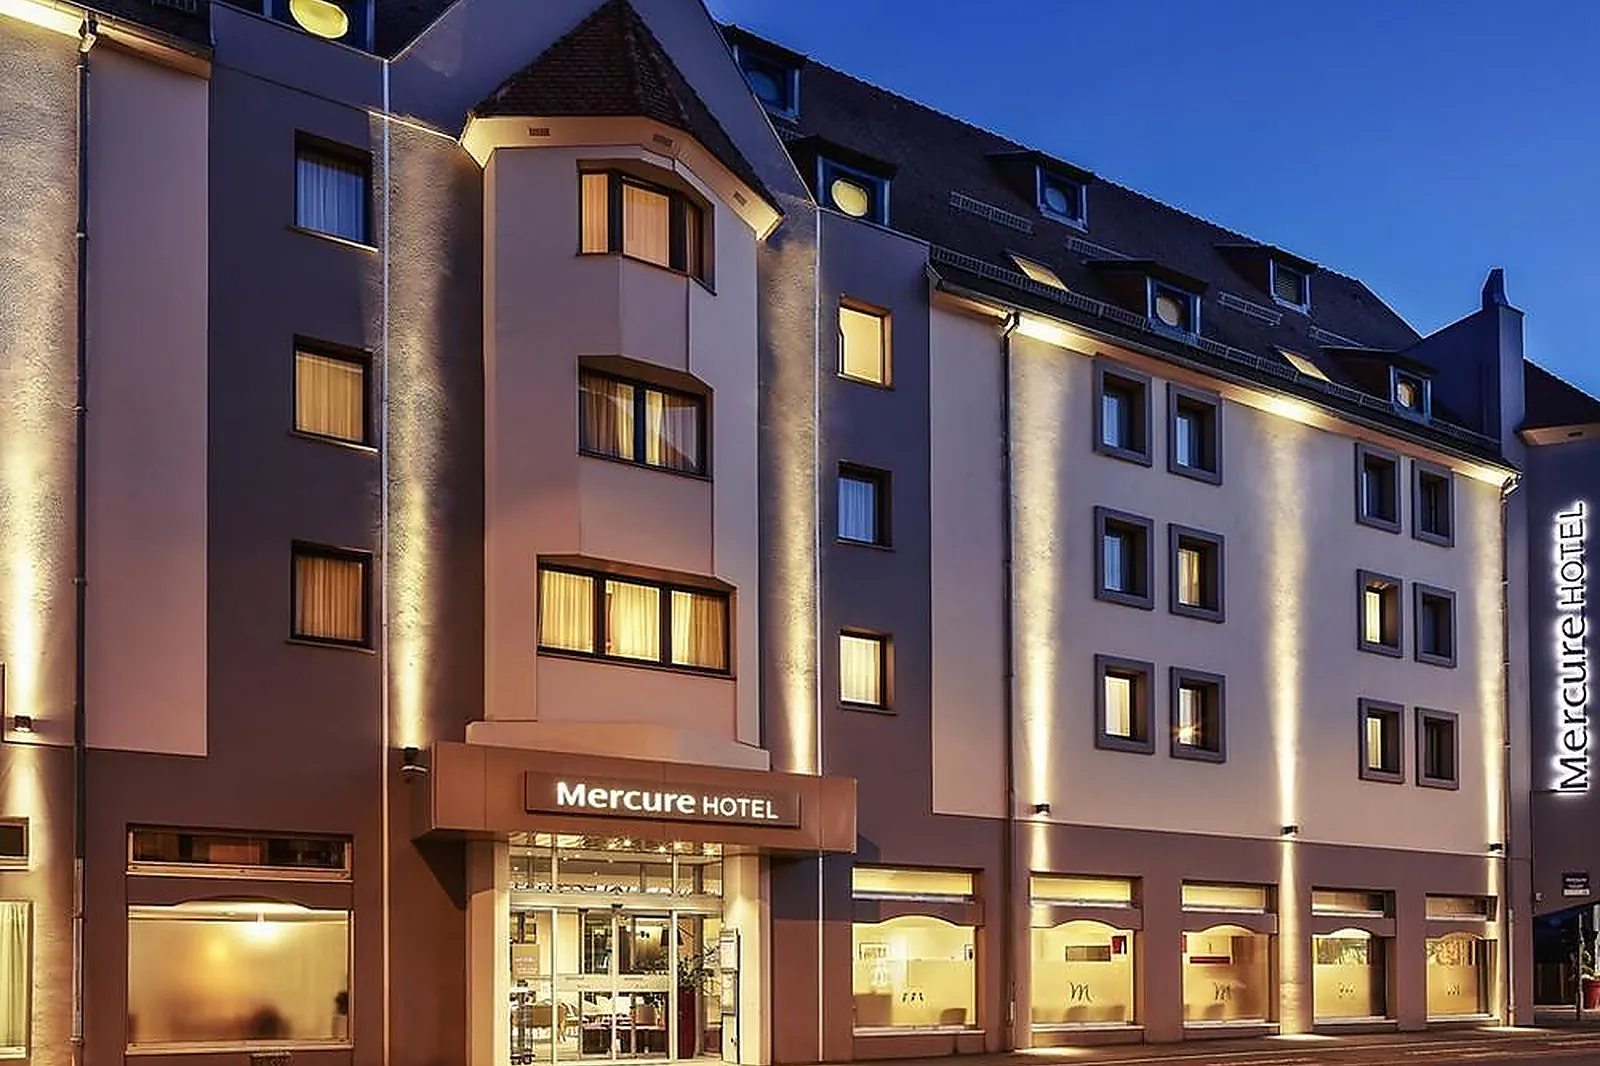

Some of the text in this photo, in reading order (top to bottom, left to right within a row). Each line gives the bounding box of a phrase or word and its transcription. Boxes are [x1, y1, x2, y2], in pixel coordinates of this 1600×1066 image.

[1560, 502, 1588, 789] Mercure HOTEL
[556, 781, 779, 819] Mercure HOTEL
